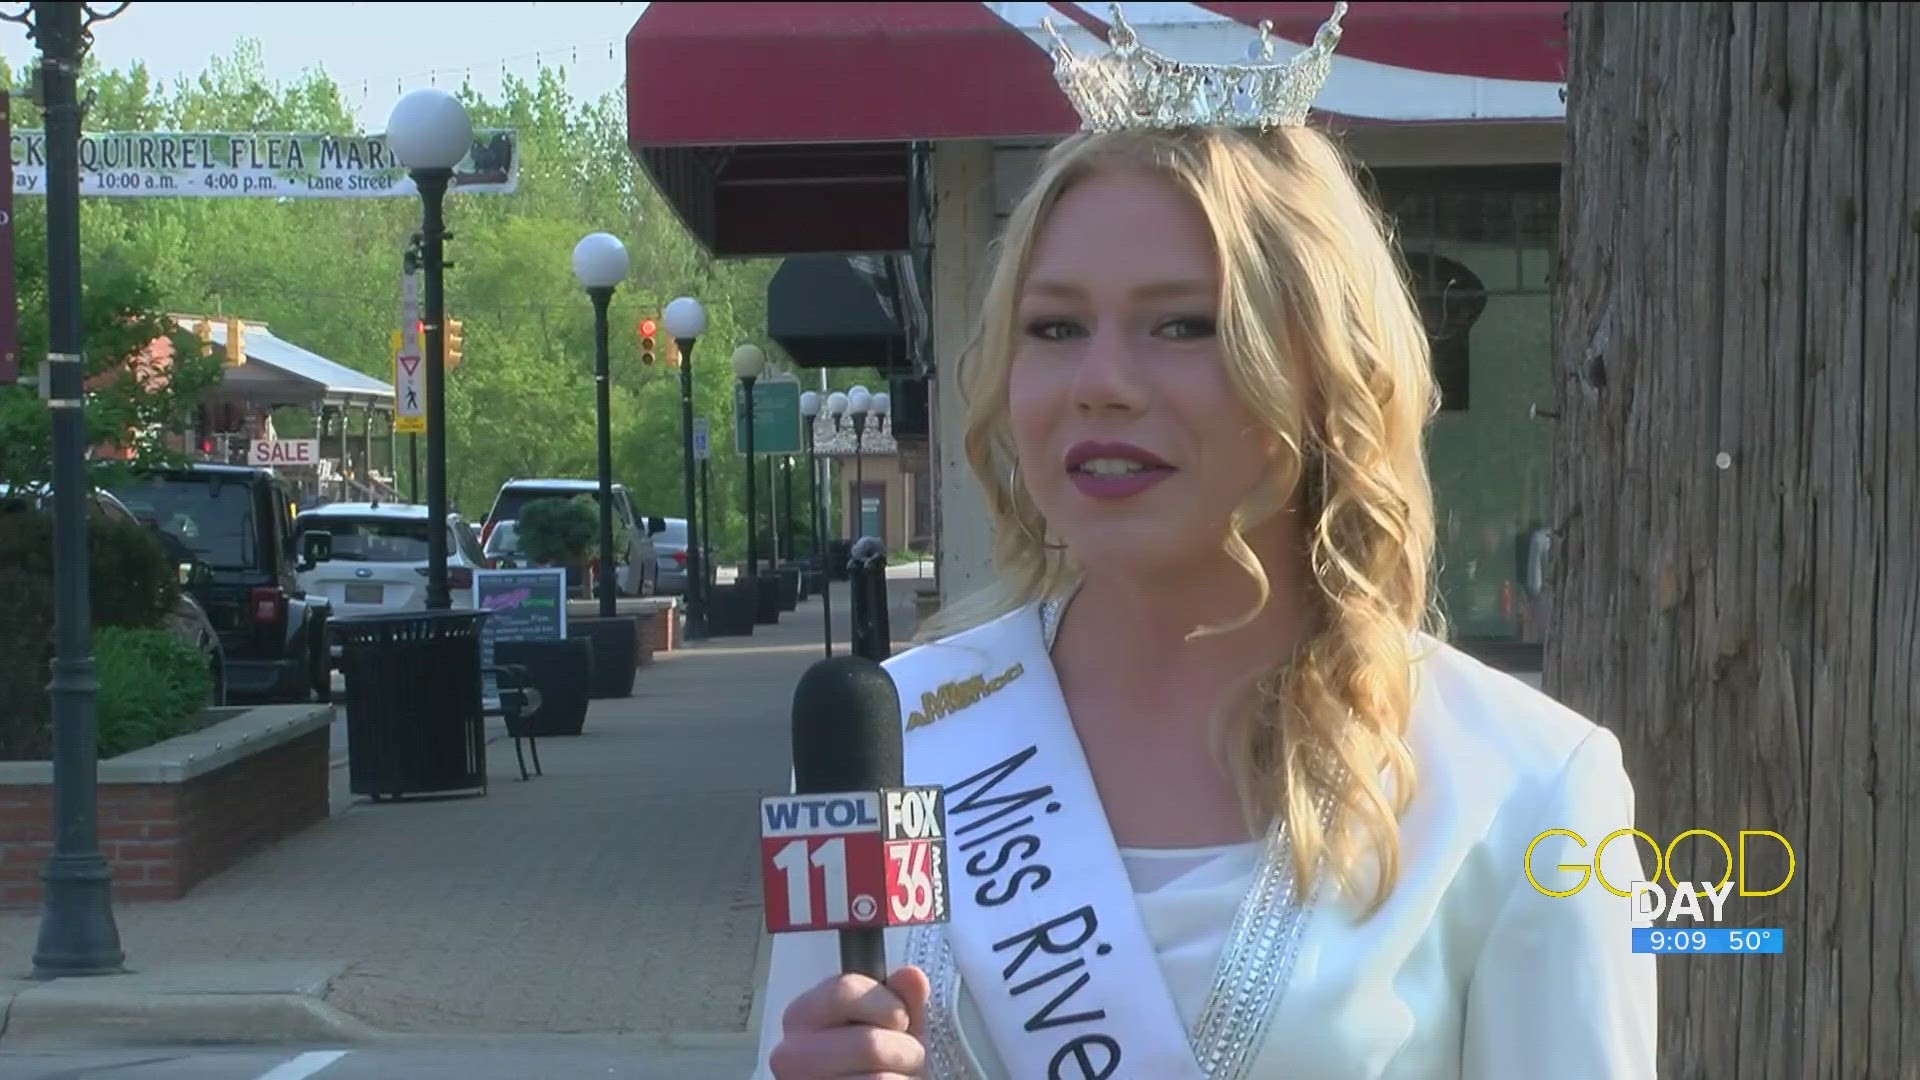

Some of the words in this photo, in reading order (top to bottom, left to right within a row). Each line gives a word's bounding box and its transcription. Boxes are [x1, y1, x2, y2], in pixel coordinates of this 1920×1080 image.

[80, 138, 215, 171] QUIRREL
[231, 139, 304, 169] FLEA
[97, 173, 140, 189] 10:00
[145, 174, 178, 189] a.m.
[204, 173, 239, 189] 4:00
[243, 175, 277, 193] p.m.
[307, 175, 343, 190] Lane
[348, 174, 392, 190] Street
[256, 443, 309, 461] SALE
[764, 799, 878, 830] WTOL
[886, 789, 941, 840] FOX
[943, 744, 1061, 907] Miss
[773, 837, 849, 926] 11
[889, 842, 935, 922] 36
